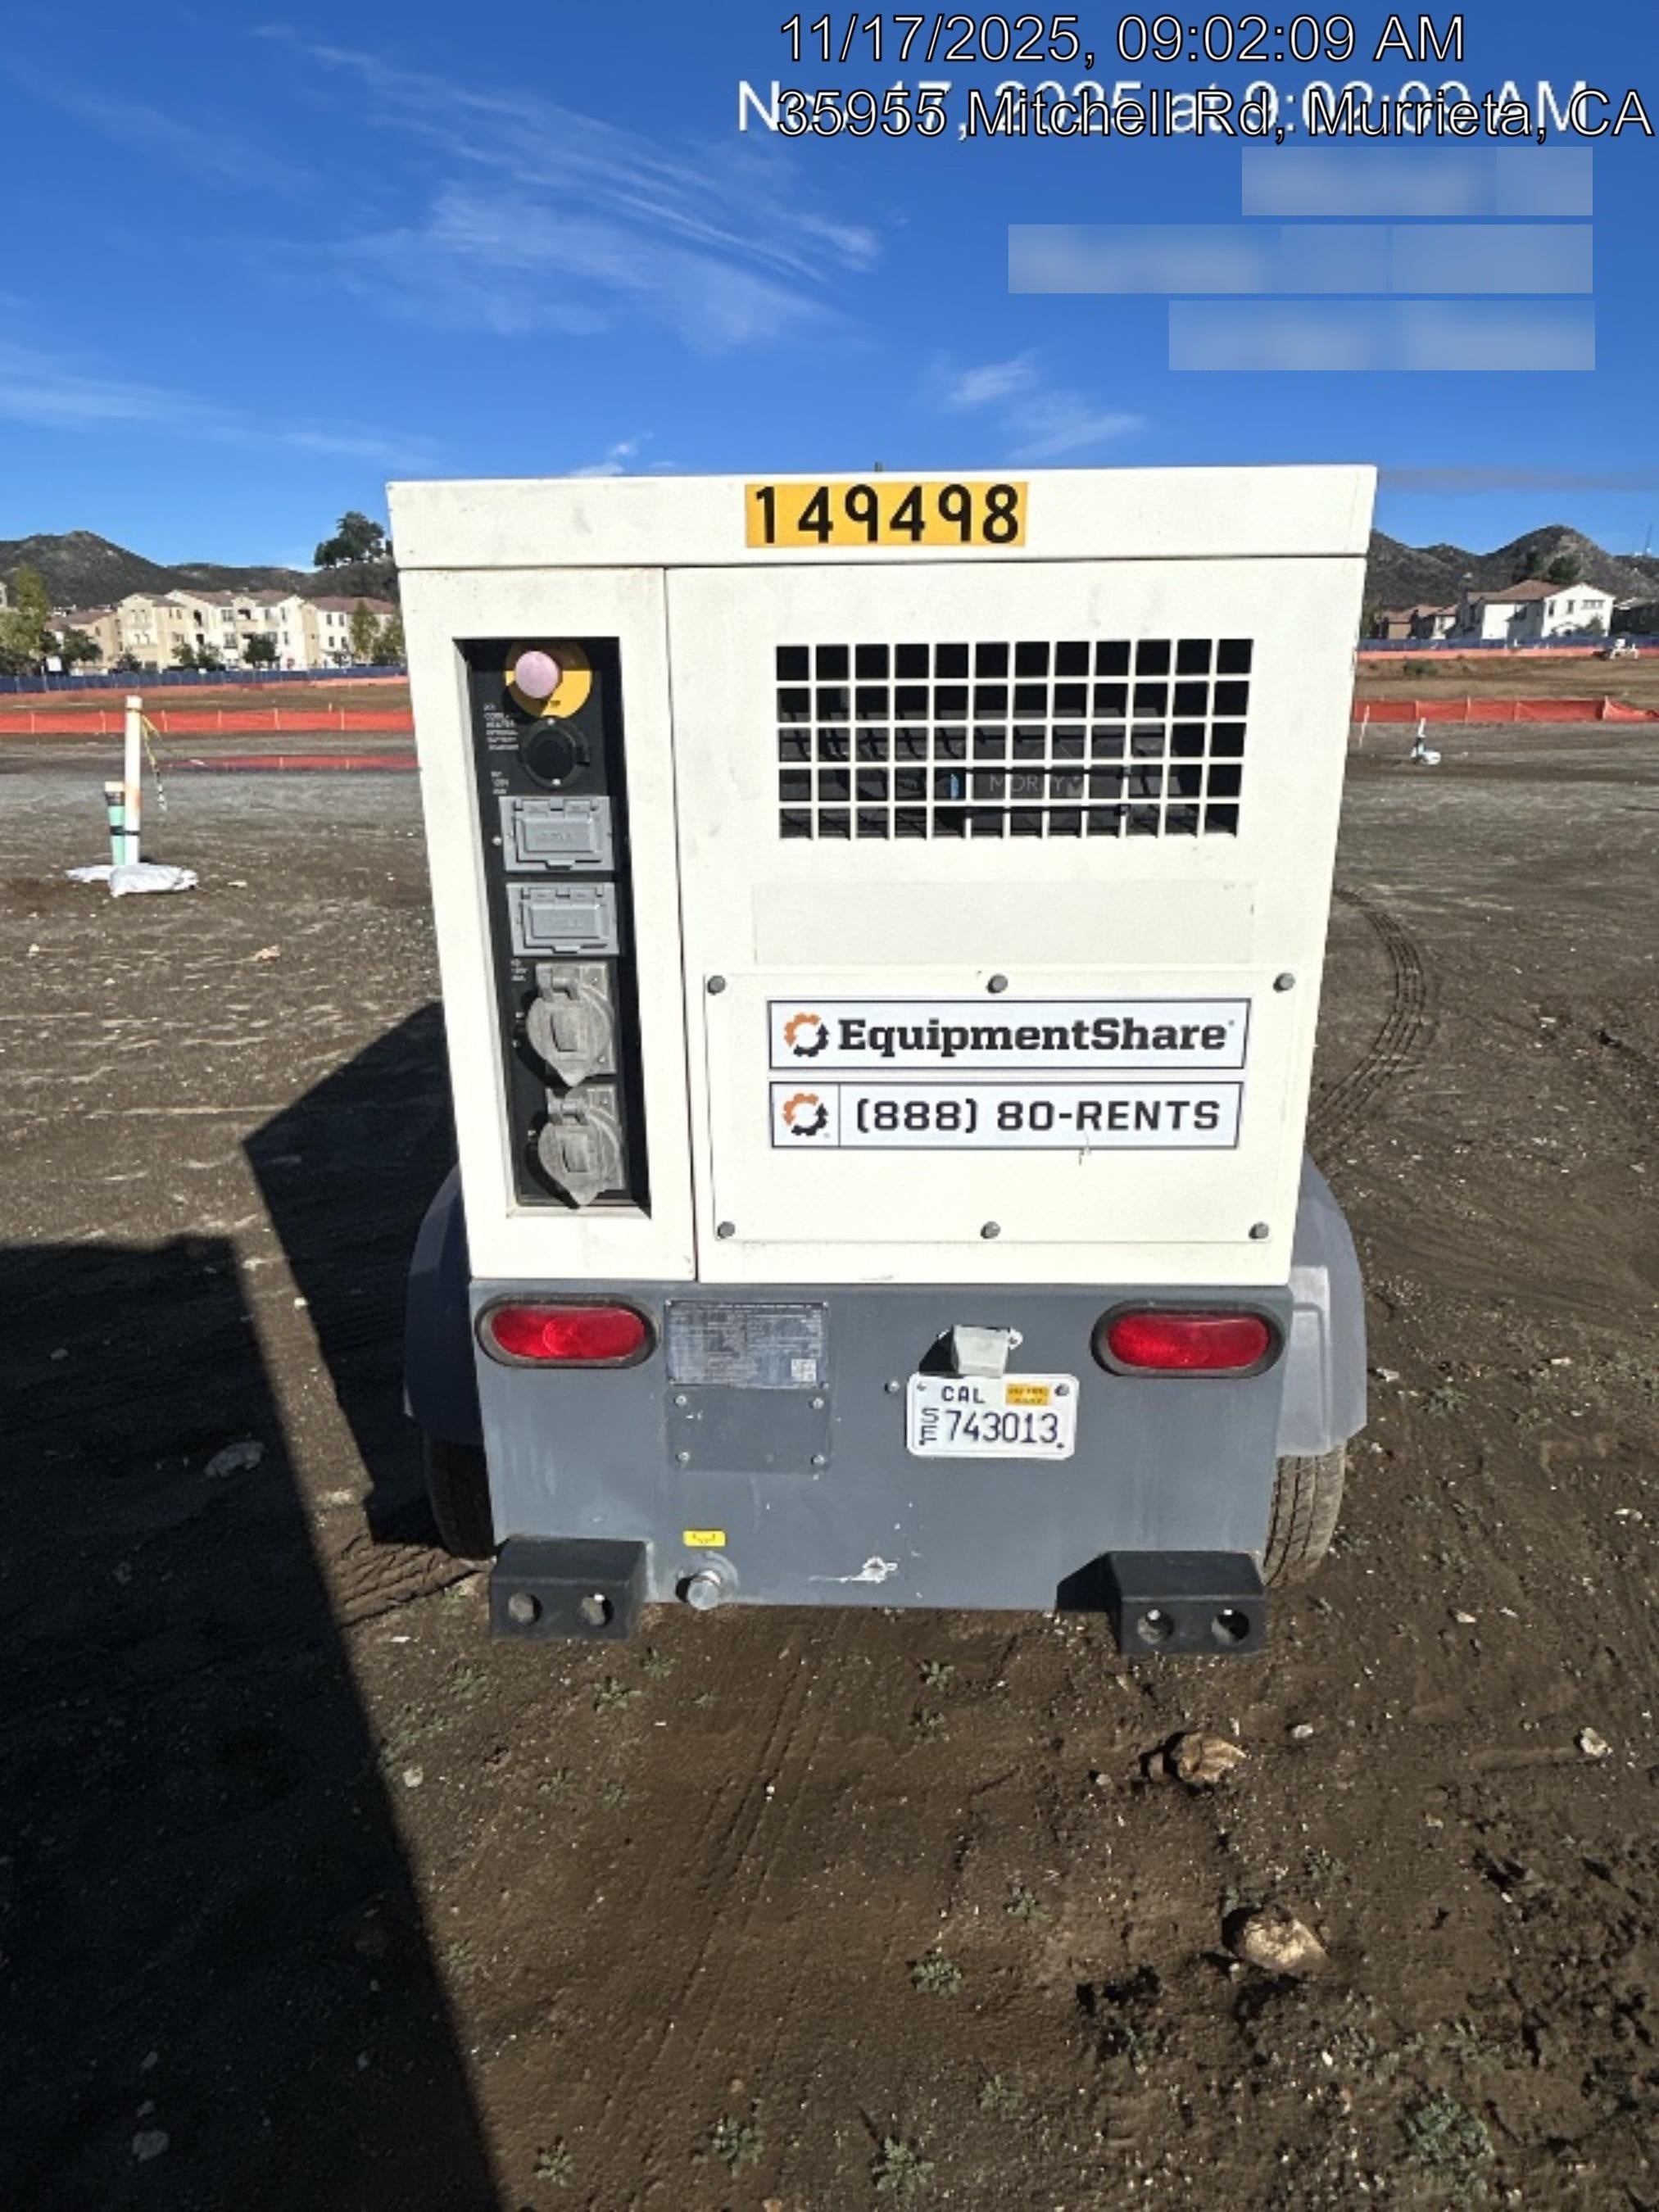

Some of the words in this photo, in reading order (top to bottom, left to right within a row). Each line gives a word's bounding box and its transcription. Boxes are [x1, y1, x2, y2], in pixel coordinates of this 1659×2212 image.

[755, 483, 1018, 543] 149498
[837, 1018, 1227, 1058] EquipmentShare
[857, 1098, 978, 1134] (888)
[997, 1099, 1220, 1131] 80-RENTS
[942, 1386, 986, 1404] CAL
[945, 1410, 1058, 1444] 743013
